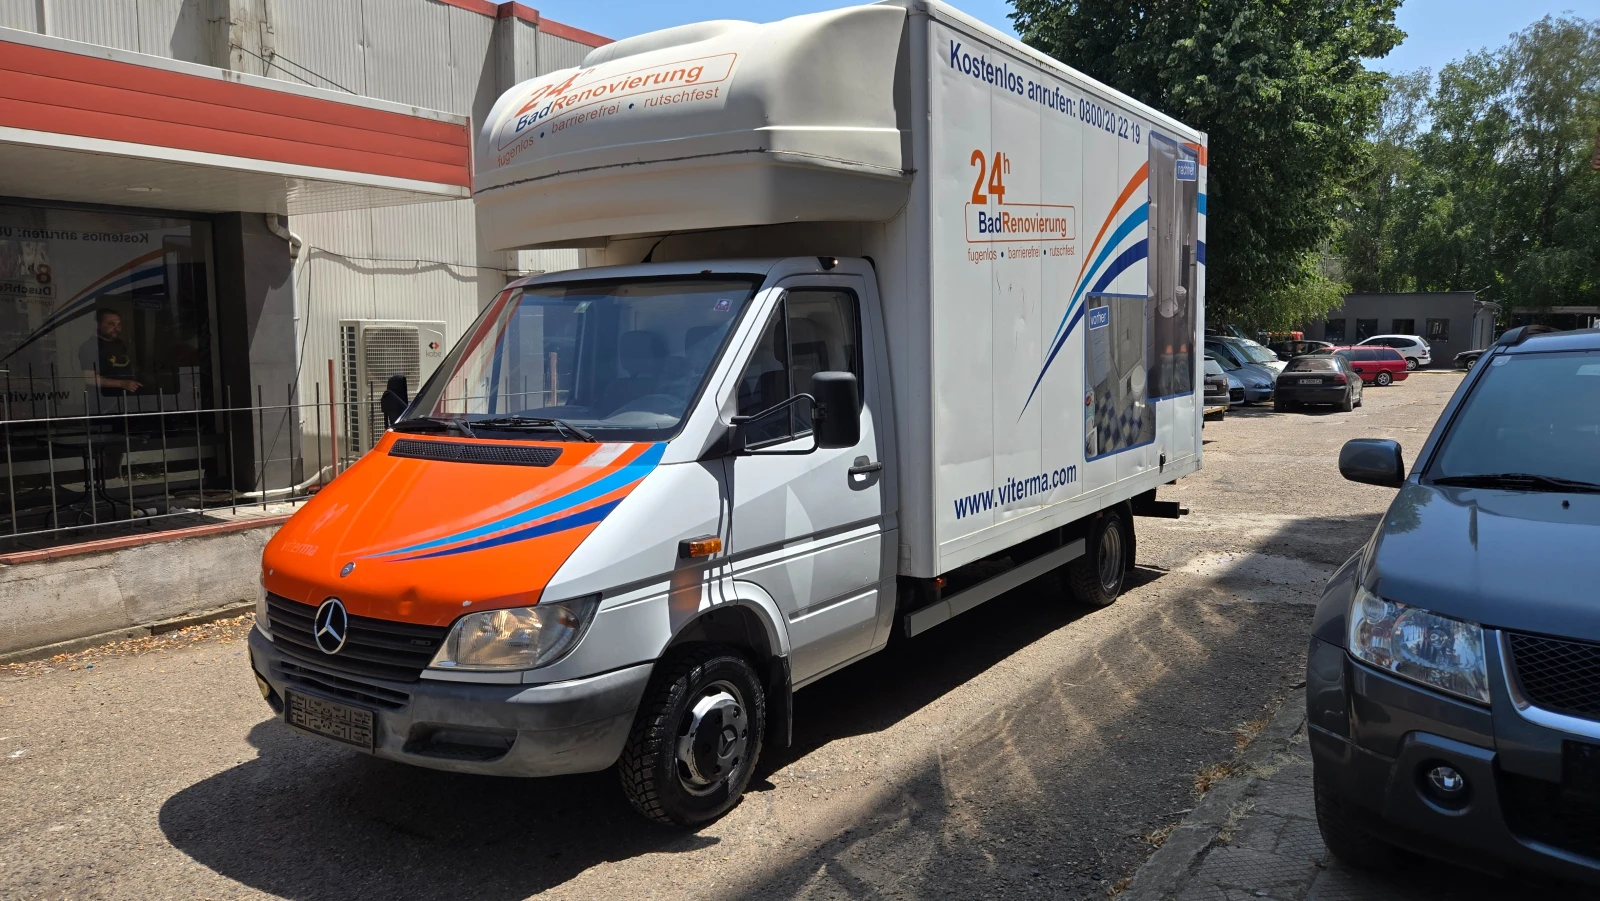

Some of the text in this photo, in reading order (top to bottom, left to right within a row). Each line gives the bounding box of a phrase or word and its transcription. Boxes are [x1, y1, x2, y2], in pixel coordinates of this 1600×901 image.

[515, 64, 704, 133] BadRenovierung
[950, 39, 1141, 145] Kostenlos anrufen: 0800/20 22 19
[497, 86, 719, 168] fugenlos barrierefrei rutschfest
[968, 245, 1075, 264] fugenlos barrierefrei rutschfest
[978, 211, 1067, 237] BadRenovierung
[954, 464, 1077, 520] www.viterma.com
